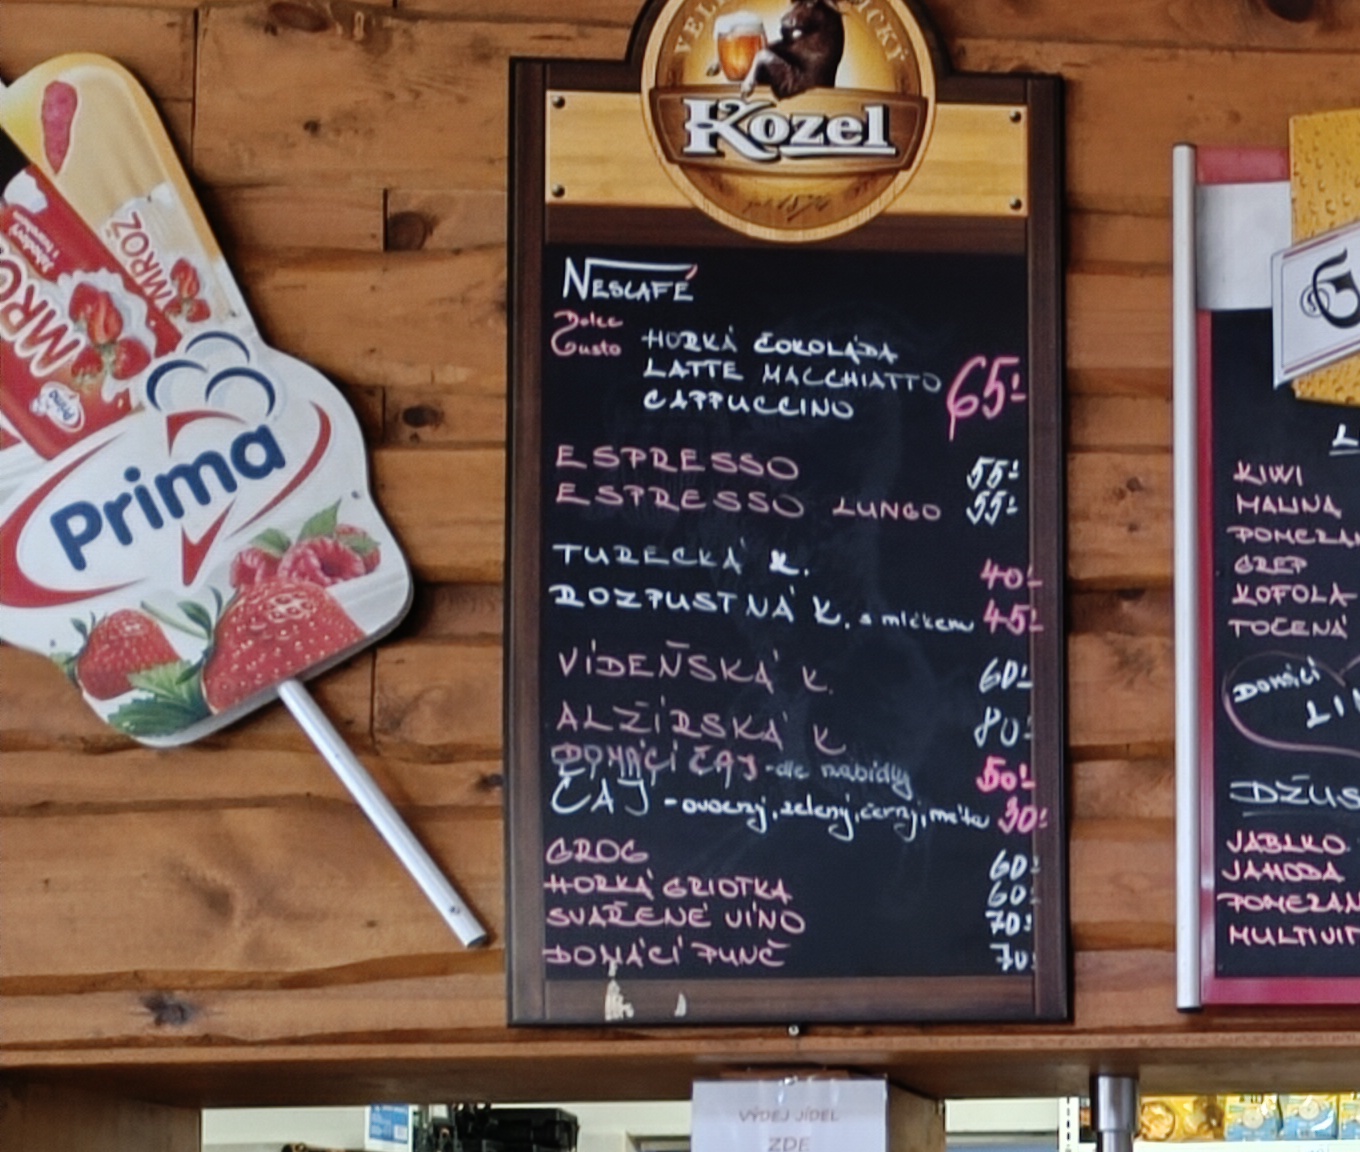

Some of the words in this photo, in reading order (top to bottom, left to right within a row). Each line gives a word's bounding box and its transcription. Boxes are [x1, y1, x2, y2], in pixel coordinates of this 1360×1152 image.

[682, 98, 897, 162] Kozel
[643, 359, 743, 382] LATTE
[763, 367, 942, 393] MACCHIATTO
[643, 391, 854, 419] CAPPUCCINO
[555, 445, 799, 480] ESPRESSO
[1233, 461, 1304, 487] KIWI
[49, 424, 286, 572] Prima
[555, 484, 805, 518] ESPRESSO
[833, 502, 941, 521] LUNGO
[1232, 583, 1358, 607] KOFOLA
[768, 1137, 809, 1152] ZDE
